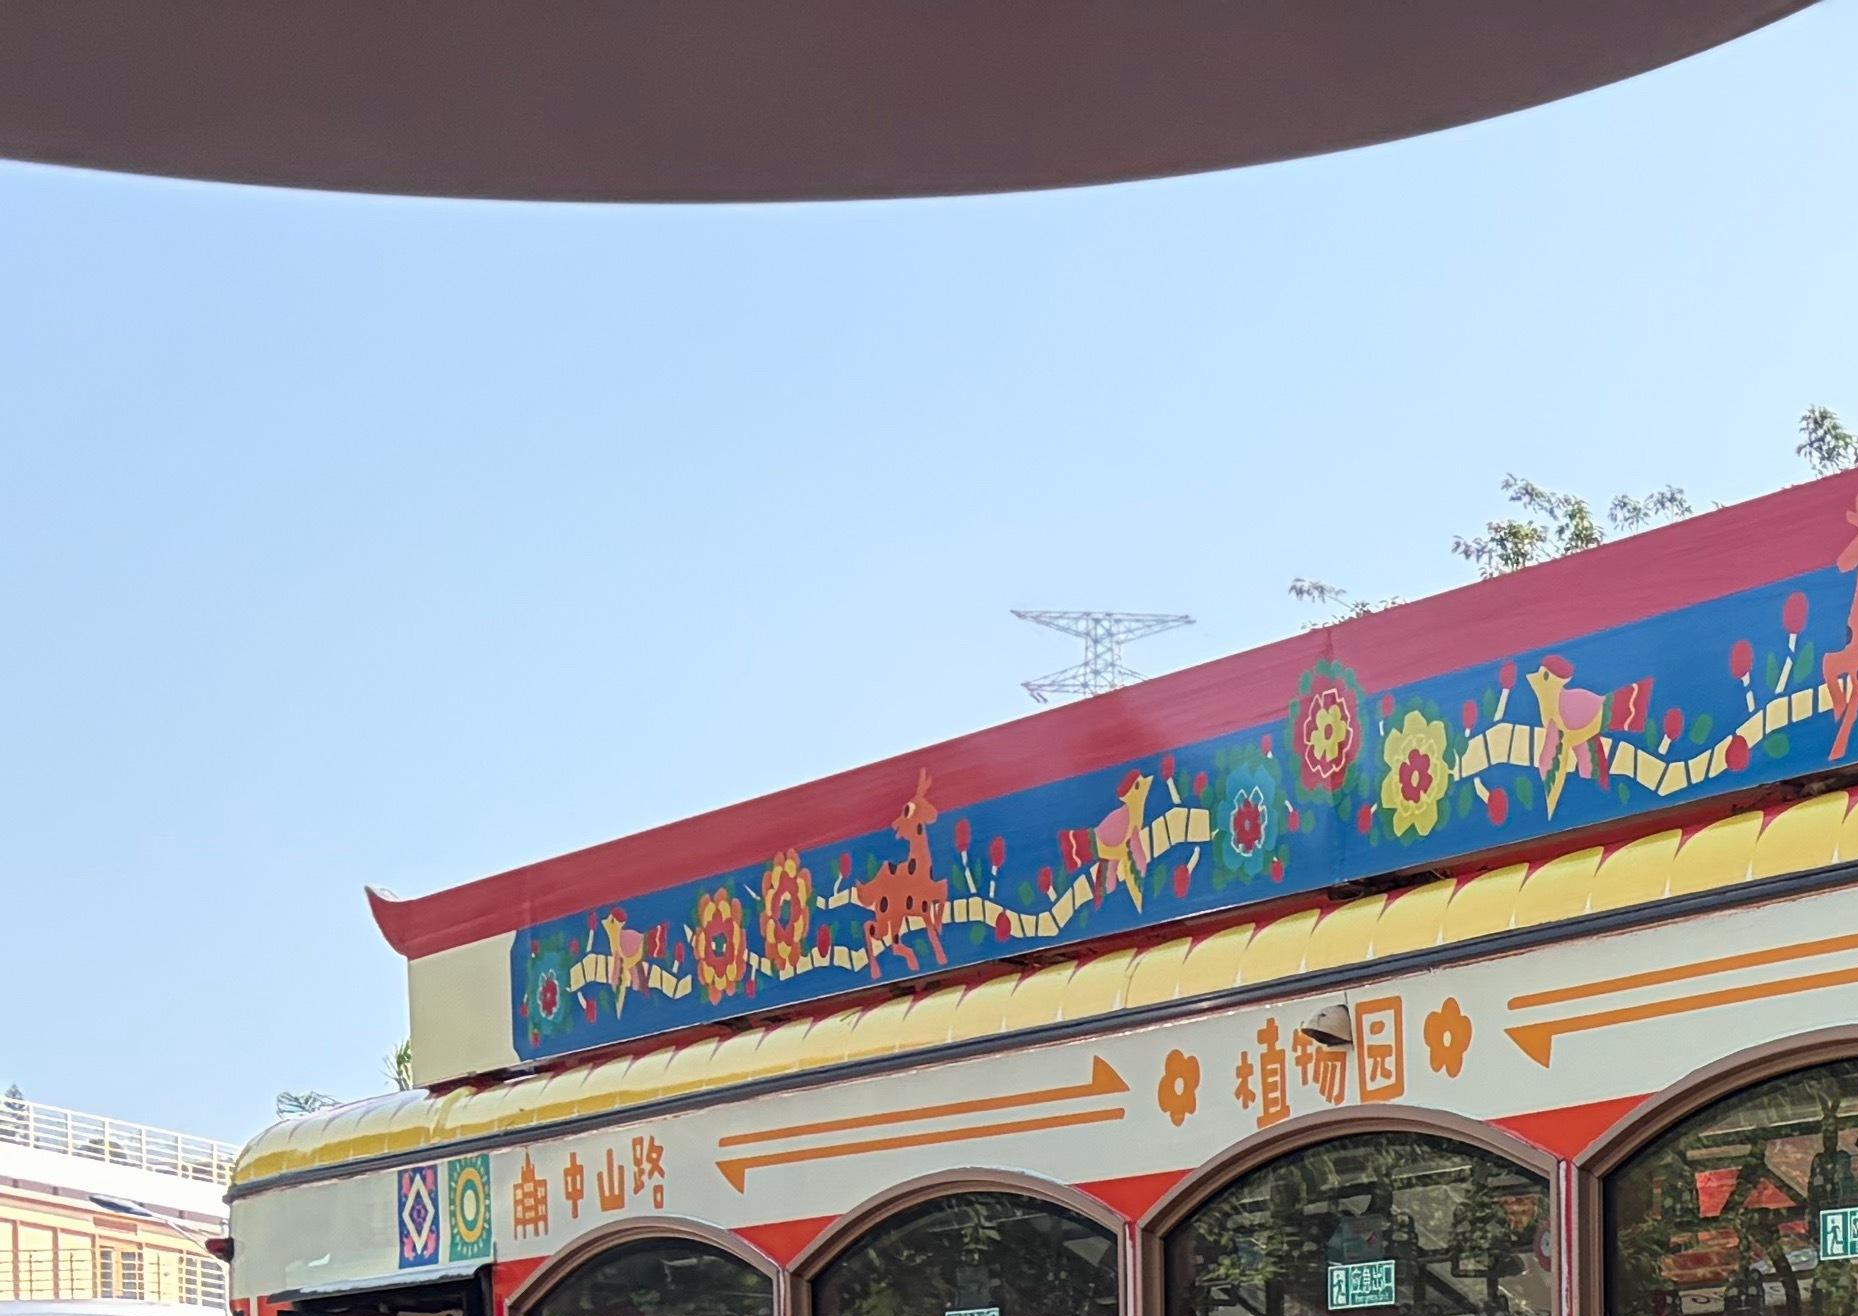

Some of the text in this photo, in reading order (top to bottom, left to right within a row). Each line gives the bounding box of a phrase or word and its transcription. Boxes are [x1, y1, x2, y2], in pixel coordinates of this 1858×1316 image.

[1235, 995, 1405, 1129] 植物园
[563, 1135, 666, 1219] 中山路
